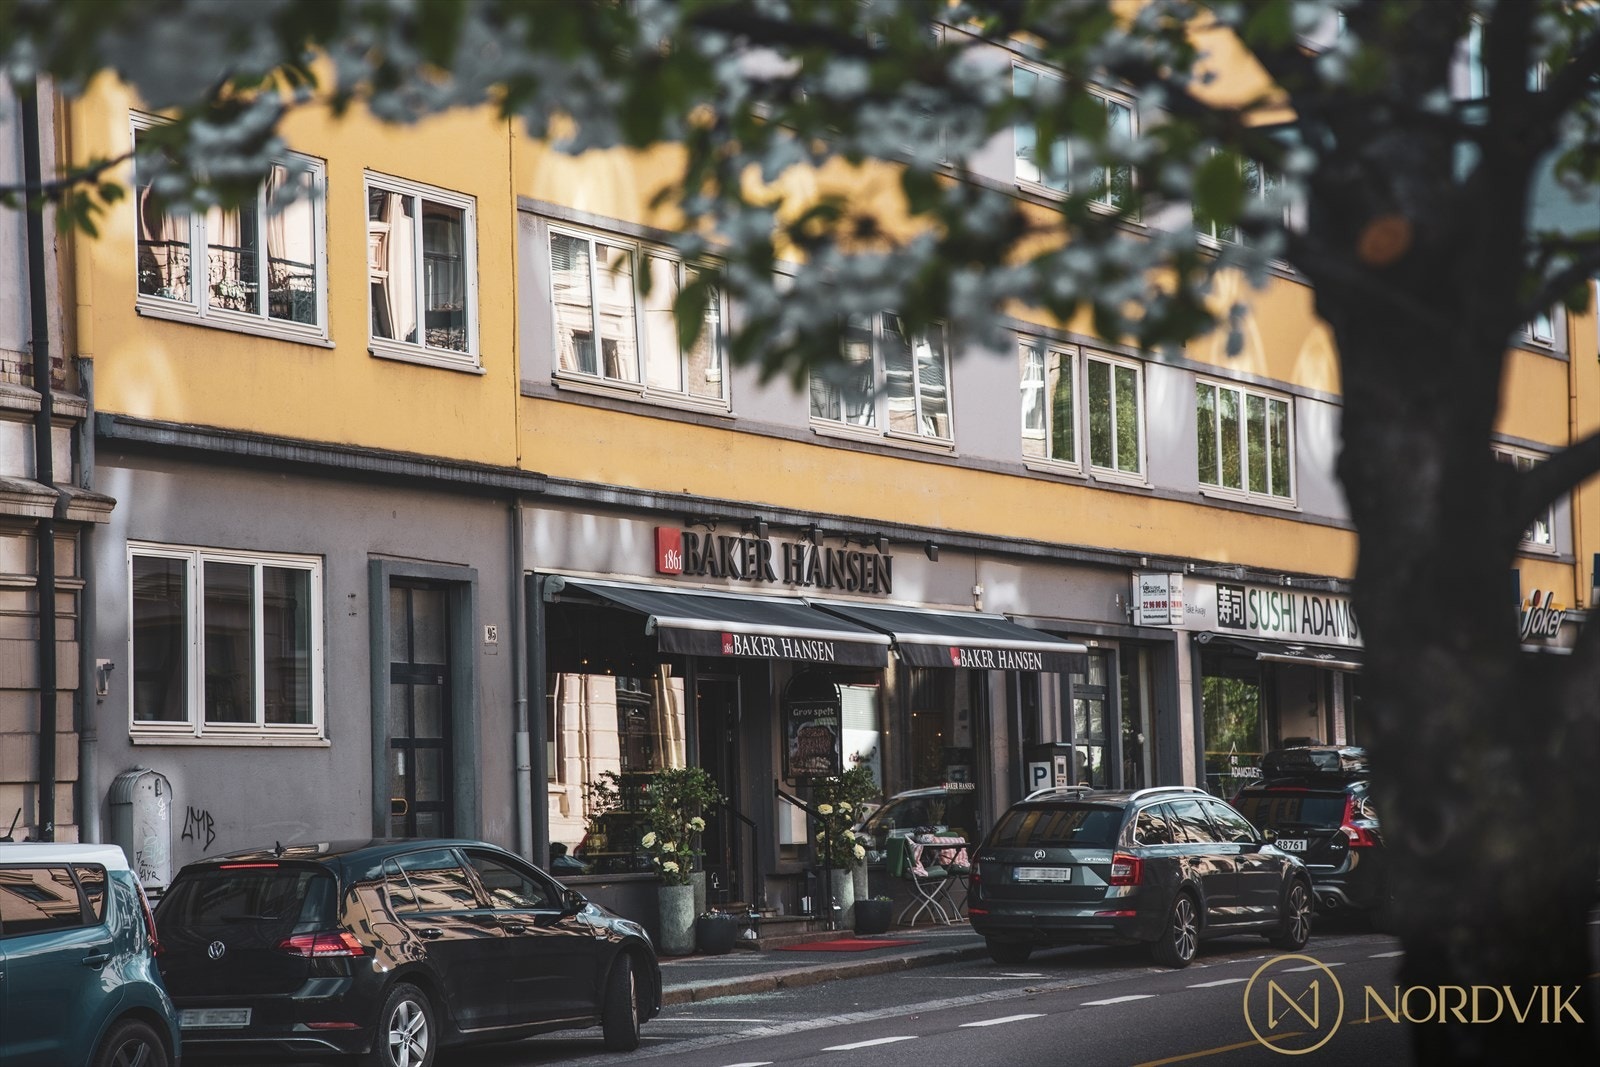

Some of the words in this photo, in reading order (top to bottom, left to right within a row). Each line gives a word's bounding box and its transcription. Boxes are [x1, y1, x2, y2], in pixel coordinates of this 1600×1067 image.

[664, 549, 682, 570] 1861
[682, 531, 778, 582] BAKER
[782, 542, 893, 594] HANSEN
[1218, 586, 1244, 625] 寿司
[1249, 588, 1297, 633] SUSHI
[1521, 588, 1567, 642] joker
[487, 627, 496, 641] 95
[733, 634, 780, 657] BAKER
[780, 637, 835, 661] HANSEN
[960, 648, 996, 668] BAKER
[998, 650, 1043, 670] HANSEN
[793, 708, 812, 716] Grov
[813, 706, 834, 717] spelt
[1034, 766, 1047, 787] P
[1231, 766, 1261, 778] ADAMSTUE
[945, 782, 958, 790] BAKER
[959, 782, 975, 790] HANSEN
[1277, 840, 1304, 850] 88761
